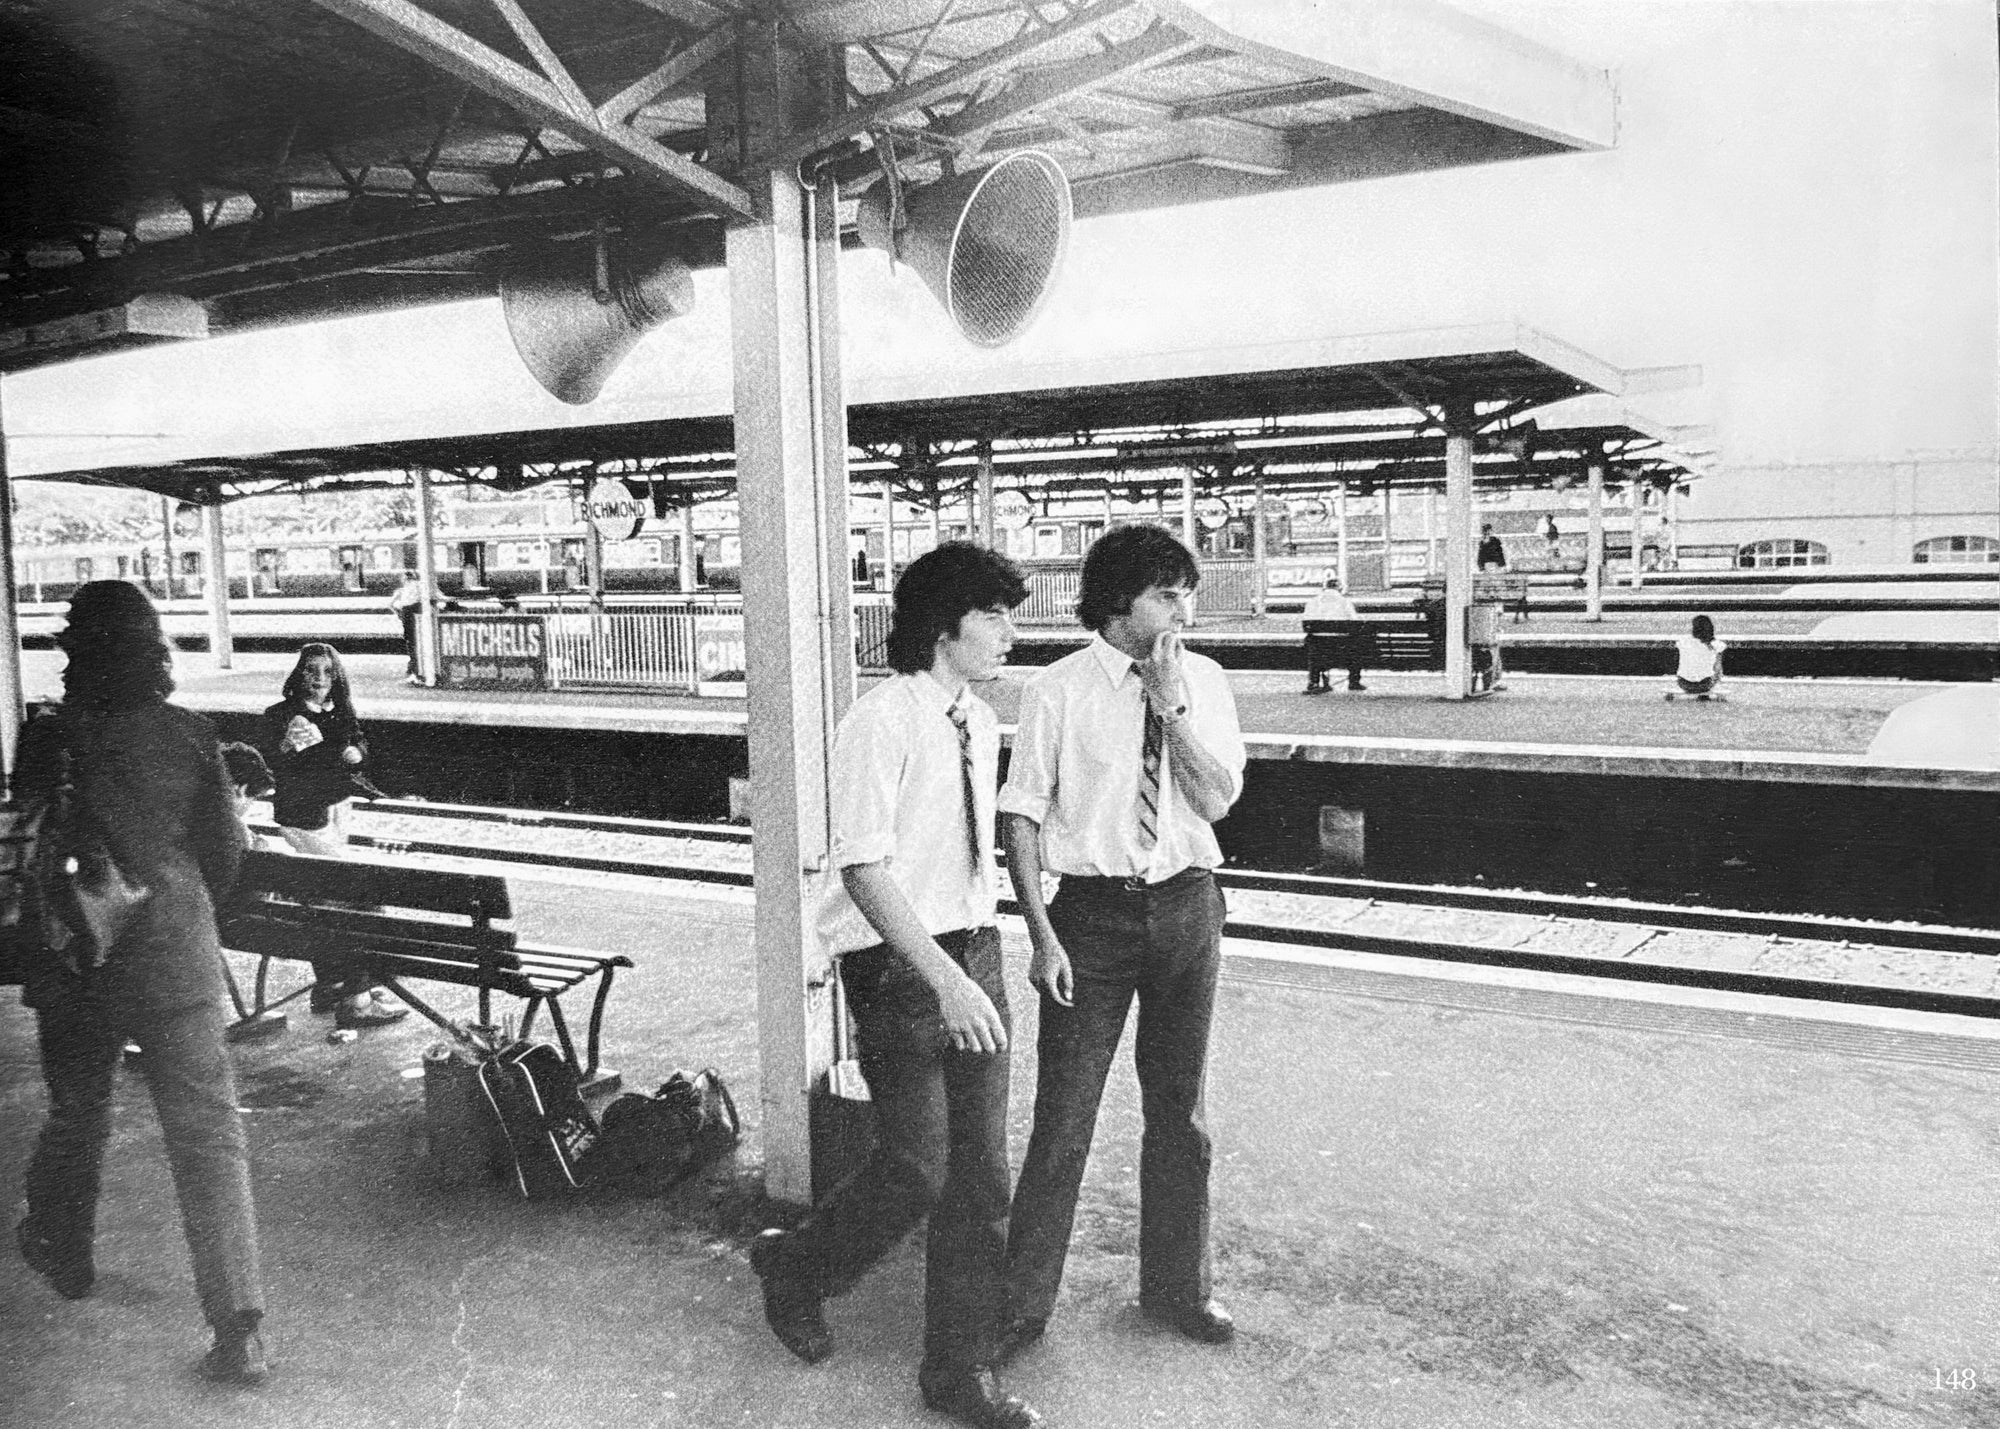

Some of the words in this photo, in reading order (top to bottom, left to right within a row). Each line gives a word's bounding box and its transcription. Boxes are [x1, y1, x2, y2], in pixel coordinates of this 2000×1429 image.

[581, 501, 646, 520] RICHMOND
[441, 622, 540, 656] MITCHELLS
[699, 641, 746, 671] CIN
